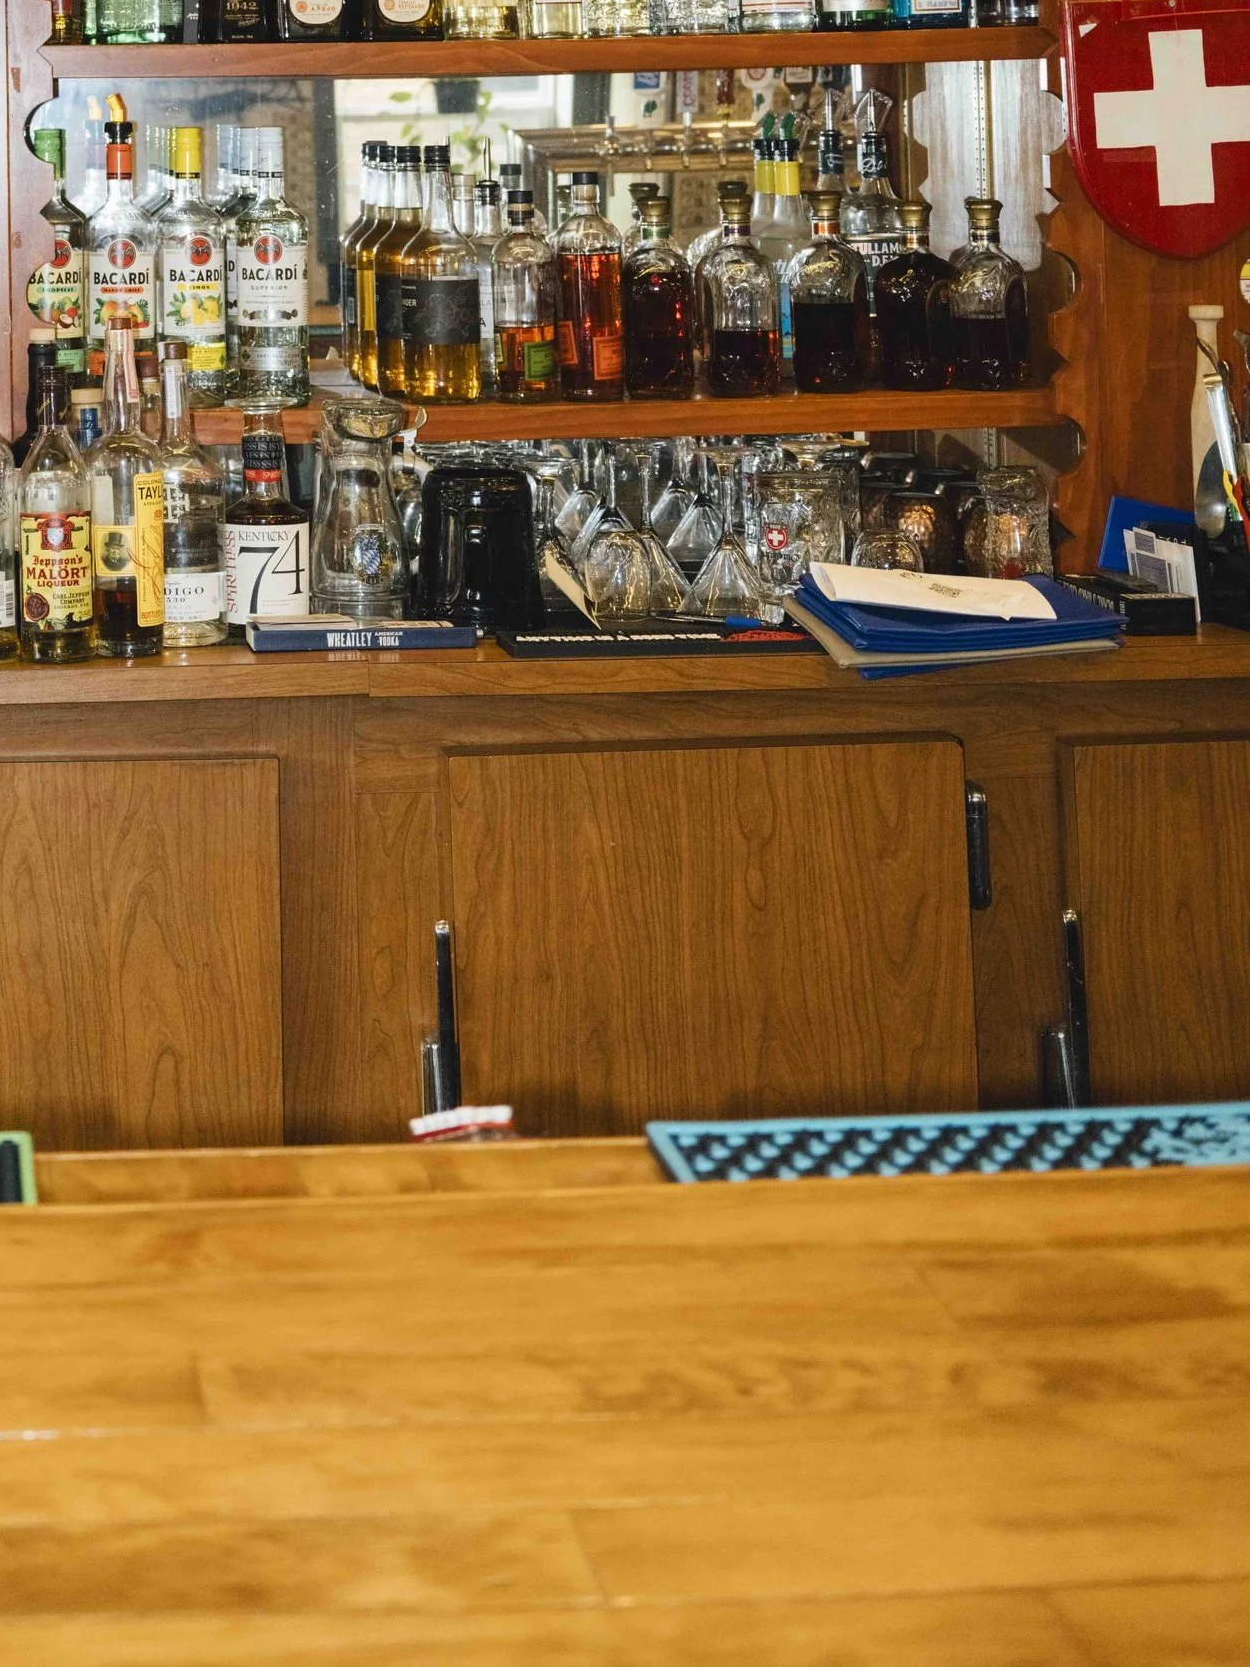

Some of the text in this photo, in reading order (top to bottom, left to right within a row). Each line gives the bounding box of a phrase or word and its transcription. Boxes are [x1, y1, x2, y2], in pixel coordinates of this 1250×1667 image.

[850, 242, 899, 254] TULLAM
[94, 268, 150, 285] BACARDÍ
[169, 266, 223, 283] BACARDÍ
[241, 265, 297, 281] BACARDÍ
[238, 530, 290, 542] KENTUCKY
[32, 555, 83, 566] Jeppson's
[26, 566, 88, 580] MALÖRT
[225, 530, 238, 614] SPIRITLESS
[37, 580, 80, 588] LIQUEUR
[326, 631, 372, 647] WHEATLEY
